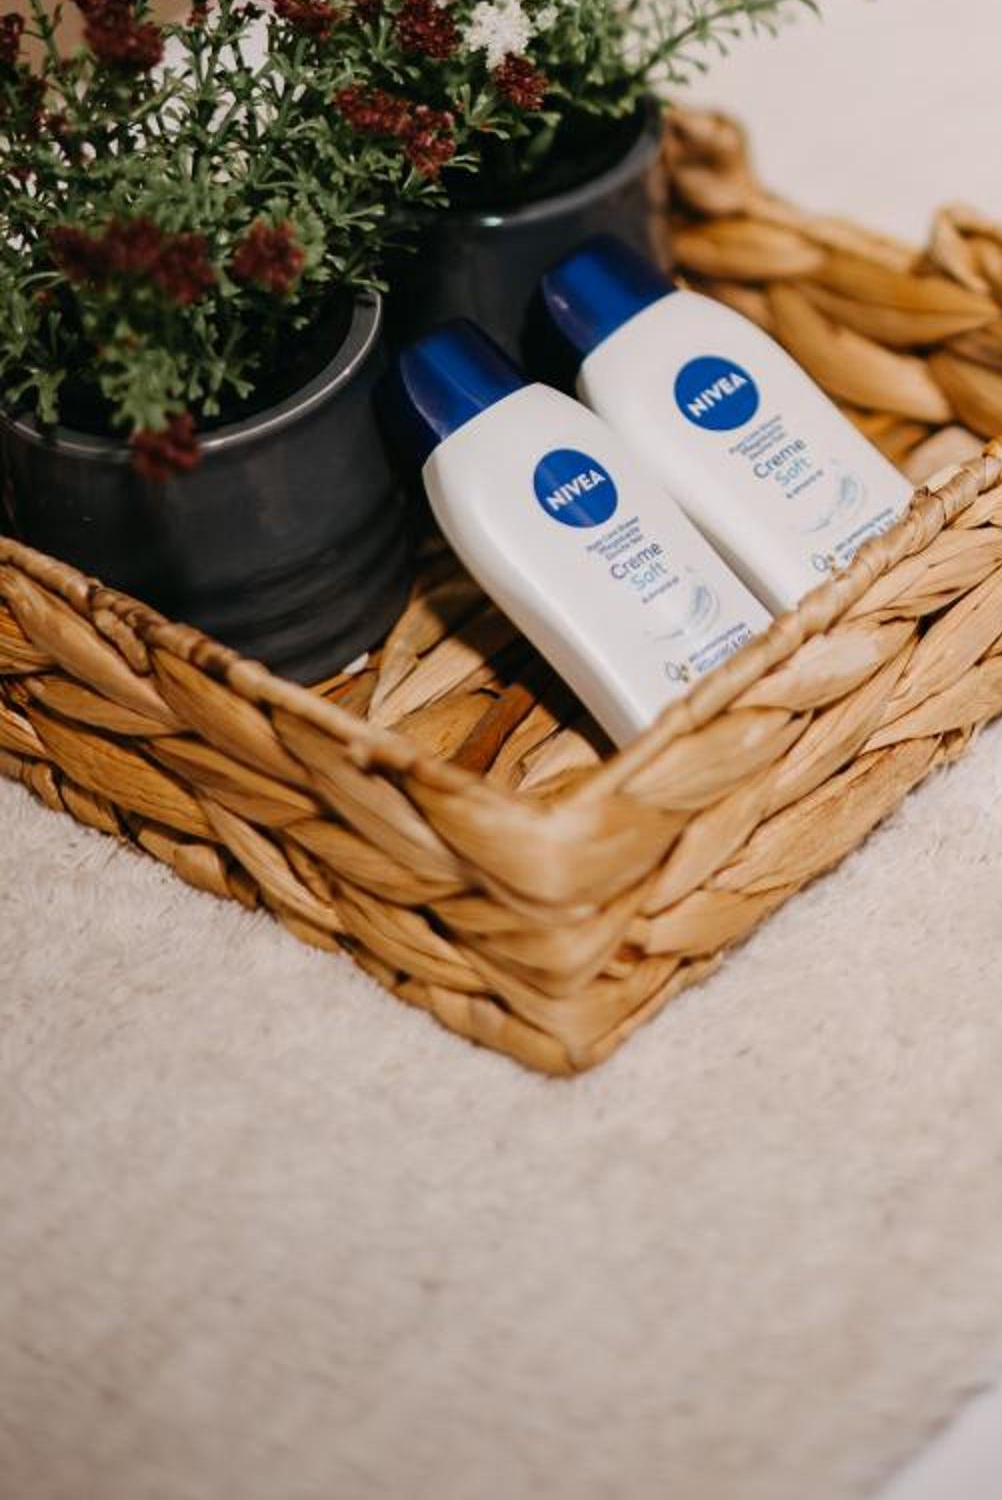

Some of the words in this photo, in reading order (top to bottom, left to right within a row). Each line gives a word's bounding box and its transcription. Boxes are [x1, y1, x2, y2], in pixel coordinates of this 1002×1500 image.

[687, 373, 748, 417] NIVEA
[752, 439, 806, 480] Creme
[774, 457, 812, 487] Soft
[545, 469, 606, 511] NIVEA
[610, 543, 664, 581] Creme
[630, 562, 669, 592] Soft
